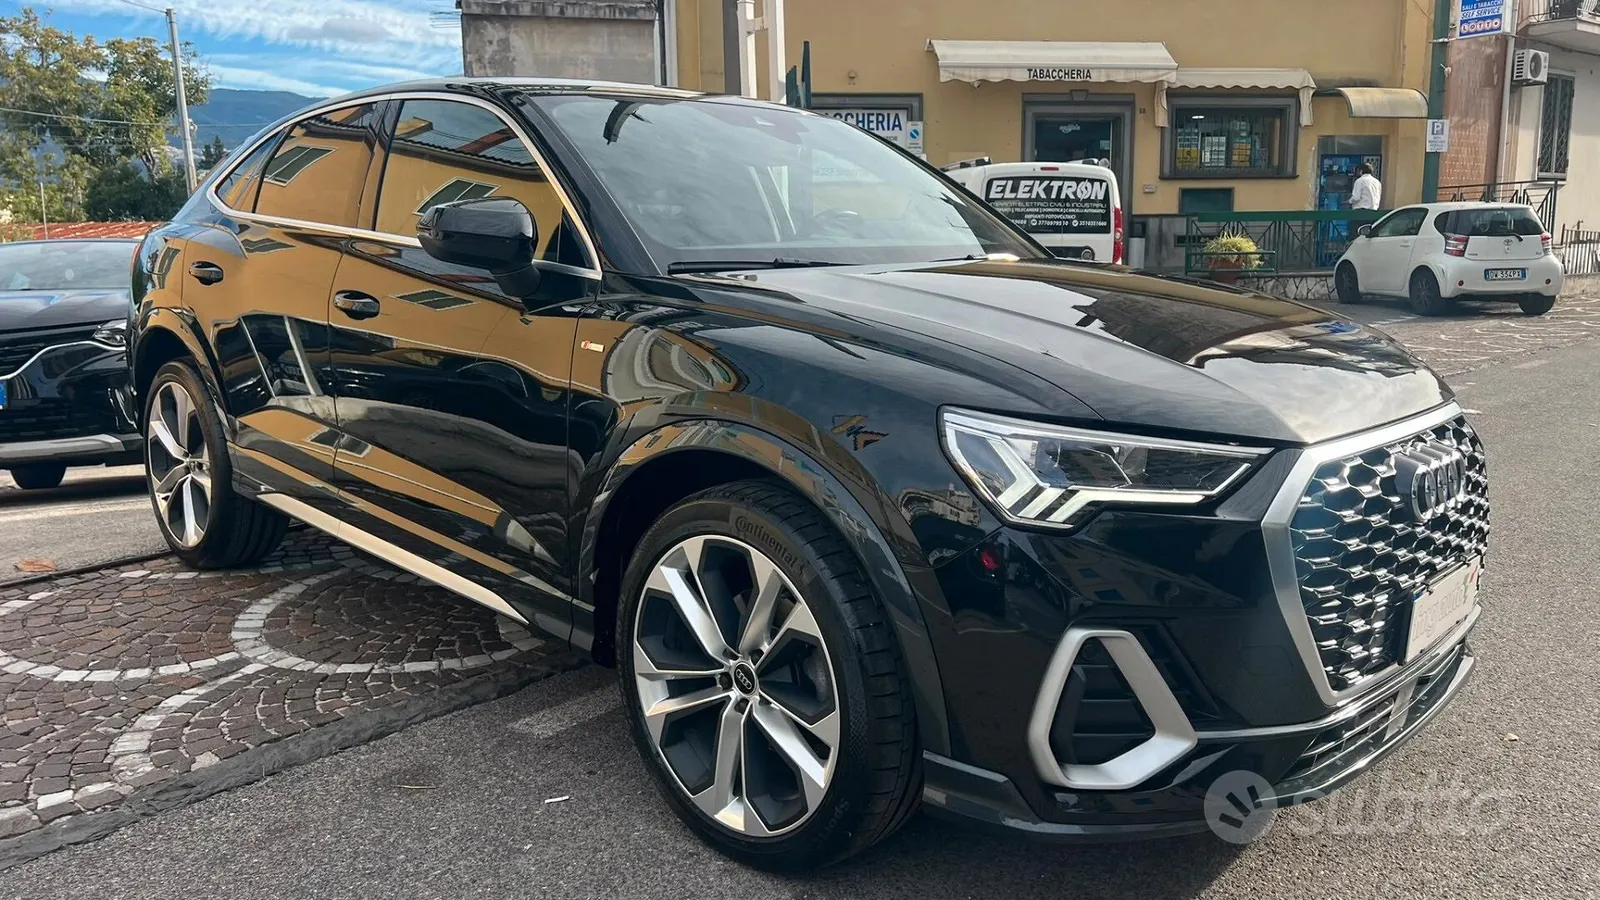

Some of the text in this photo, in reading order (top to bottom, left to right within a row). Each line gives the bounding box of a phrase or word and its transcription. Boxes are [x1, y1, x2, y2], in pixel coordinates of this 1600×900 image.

[1462, 7, 1501, 18] SELF SERVICE
[1462, 20, 1500, 32] LOTTO
[1027, 69, 1092, 80] TABACCHERIA
[989, 179, 1107, 201] ELEKTRON
[735, 516, 799, 568] Continental
